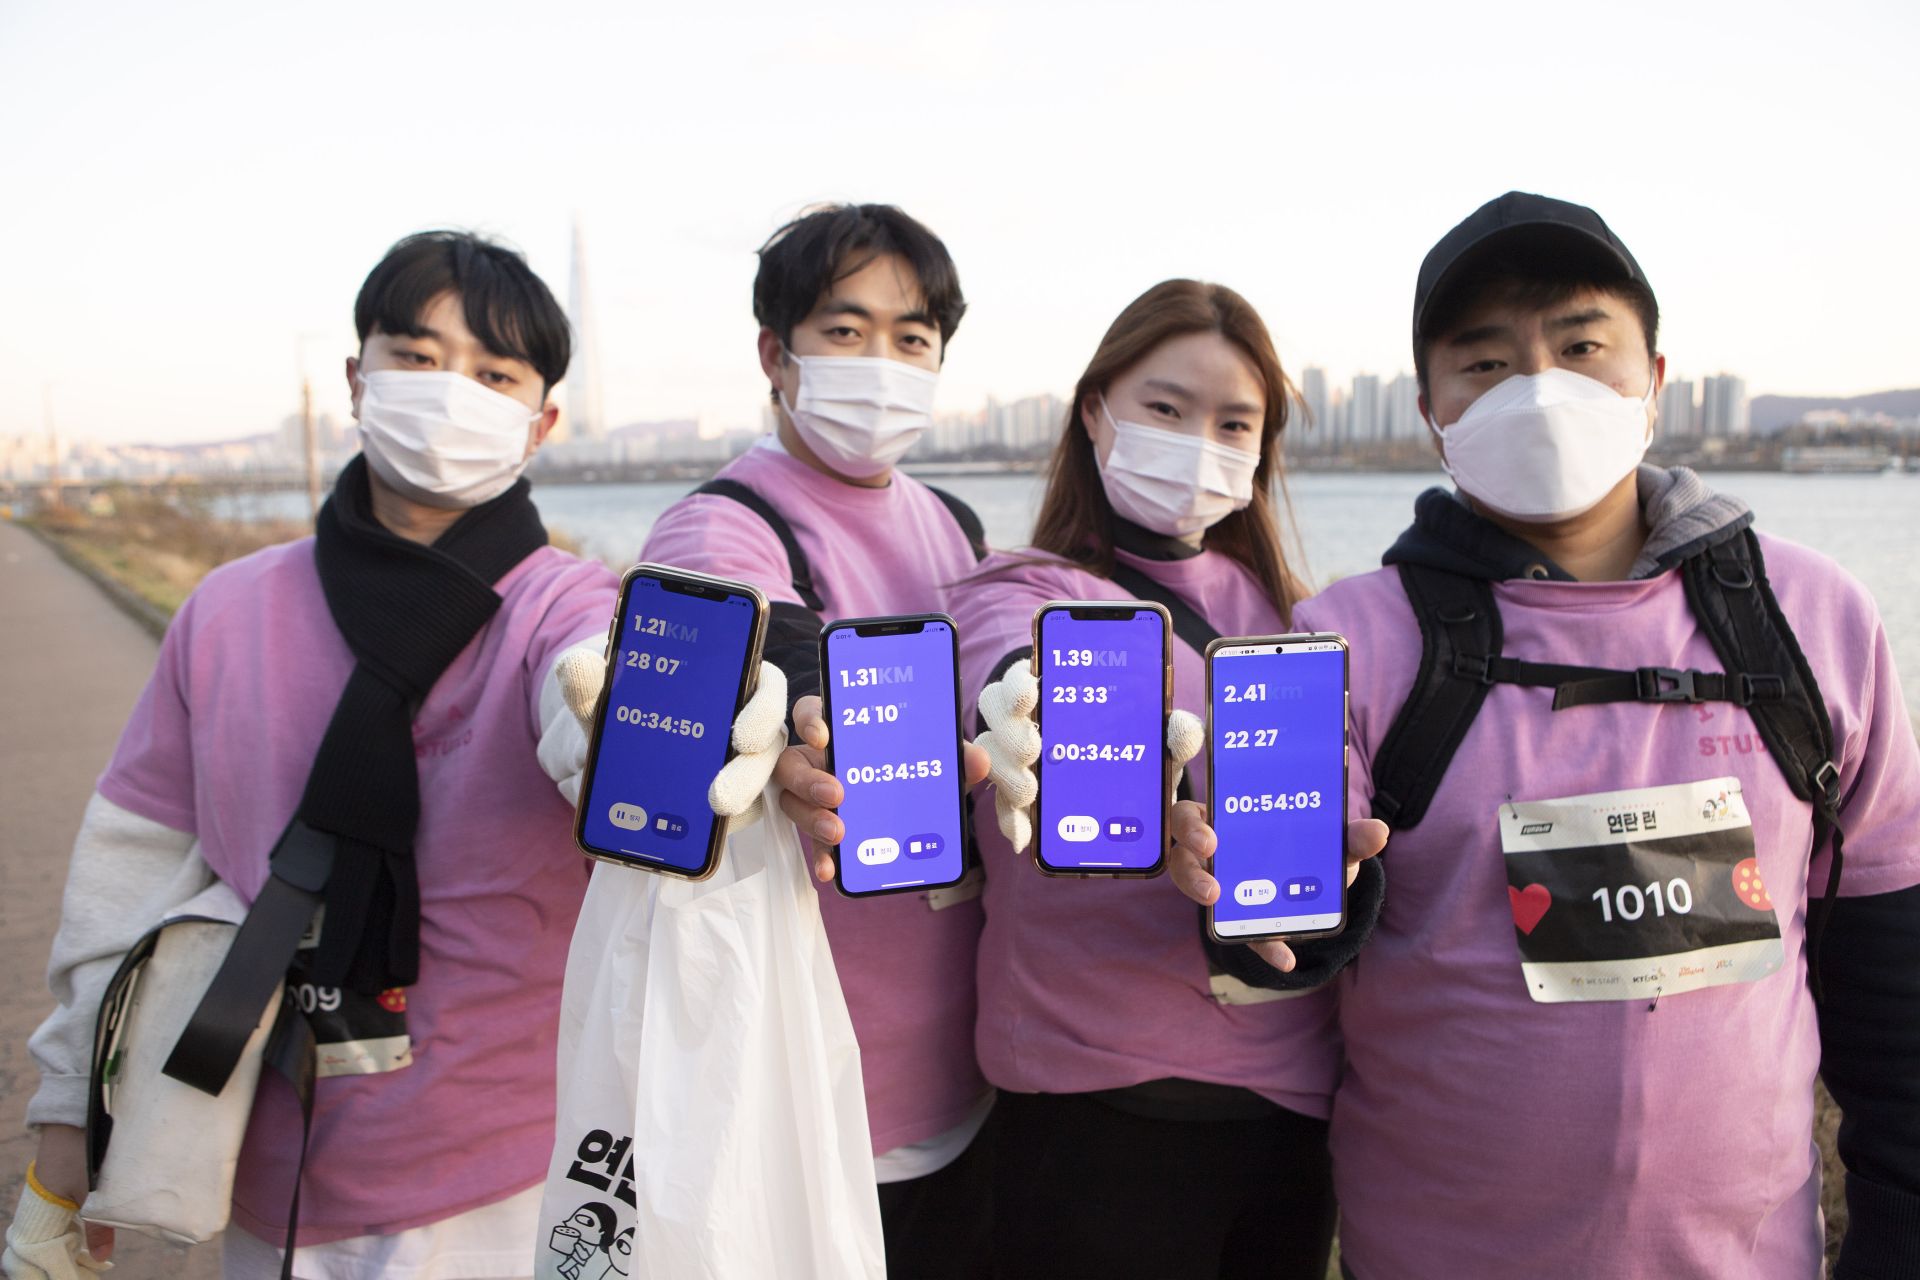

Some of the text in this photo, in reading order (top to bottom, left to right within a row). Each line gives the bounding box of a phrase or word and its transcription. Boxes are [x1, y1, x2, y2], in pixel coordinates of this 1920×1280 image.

[633, 613, 699, 643] 1.21KM
[1052, 649, 1127, 667] 1.39KM
[840, 665, 914, 688] 1.31KM
[616, 705, 706, 739] 00:34:50
[1052, 743, 1146, 762] 00:34:47
[846, 759, 943, 785] 00:34:53
[1224, 790, 1322, 814] 00:54:03
[1607, 810, 1657, 835] 연탄 런
[1591, 877, 1693, 923] 1010
